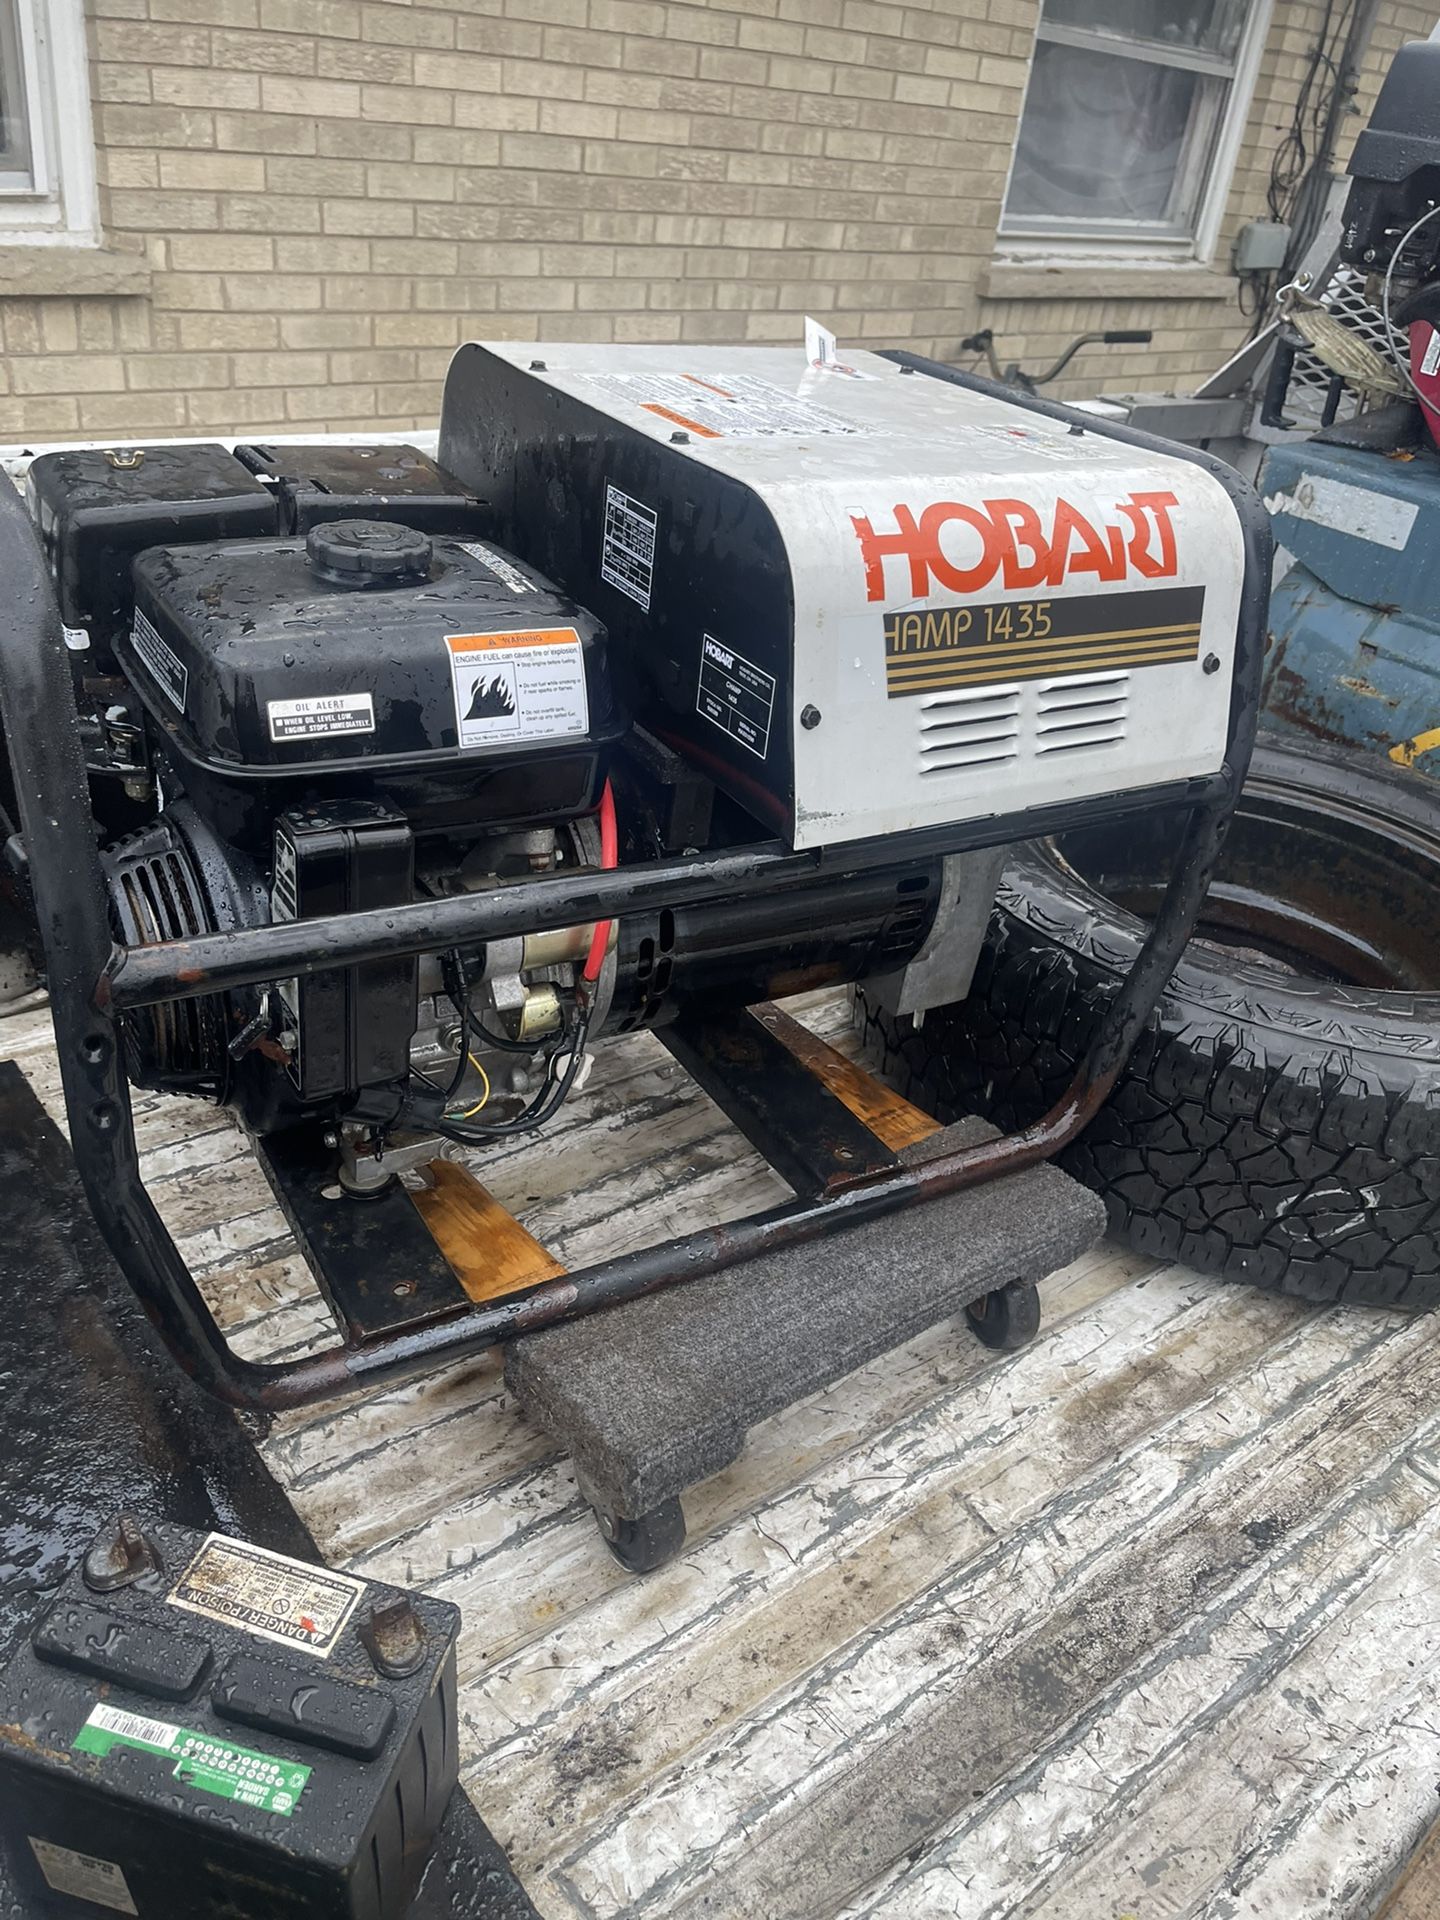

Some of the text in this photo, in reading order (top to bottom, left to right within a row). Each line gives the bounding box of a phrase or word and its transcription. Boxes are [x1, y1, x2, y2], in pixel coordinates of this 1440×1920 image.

[849, 491, 1179, 602] HOBART
[984, 602, 1051, 642] 1435
[503, 636, 543, 645] WARNING
[456, 656, 482, 664] ENGINE
[551, 647, 578, 655] explosion
[705, 640, 735, 669] HOBART
[295, 700, 345, 712] OIL ALERT
[284, 717, 303, 726] WHEN
[305, 716, 315, 724] OIL
[317, 714, 336, 722] LEVEL
[285, 719, 371, 734] ENGINE STOPS IMMEDIATELY.
[188, 1589, 239, 1616] POISON
[250, 1609, 308, 1639] DANGER
[237, 1779, 270, 1796] GARDEN
[242, 1791, 265, 1806] LAWN
